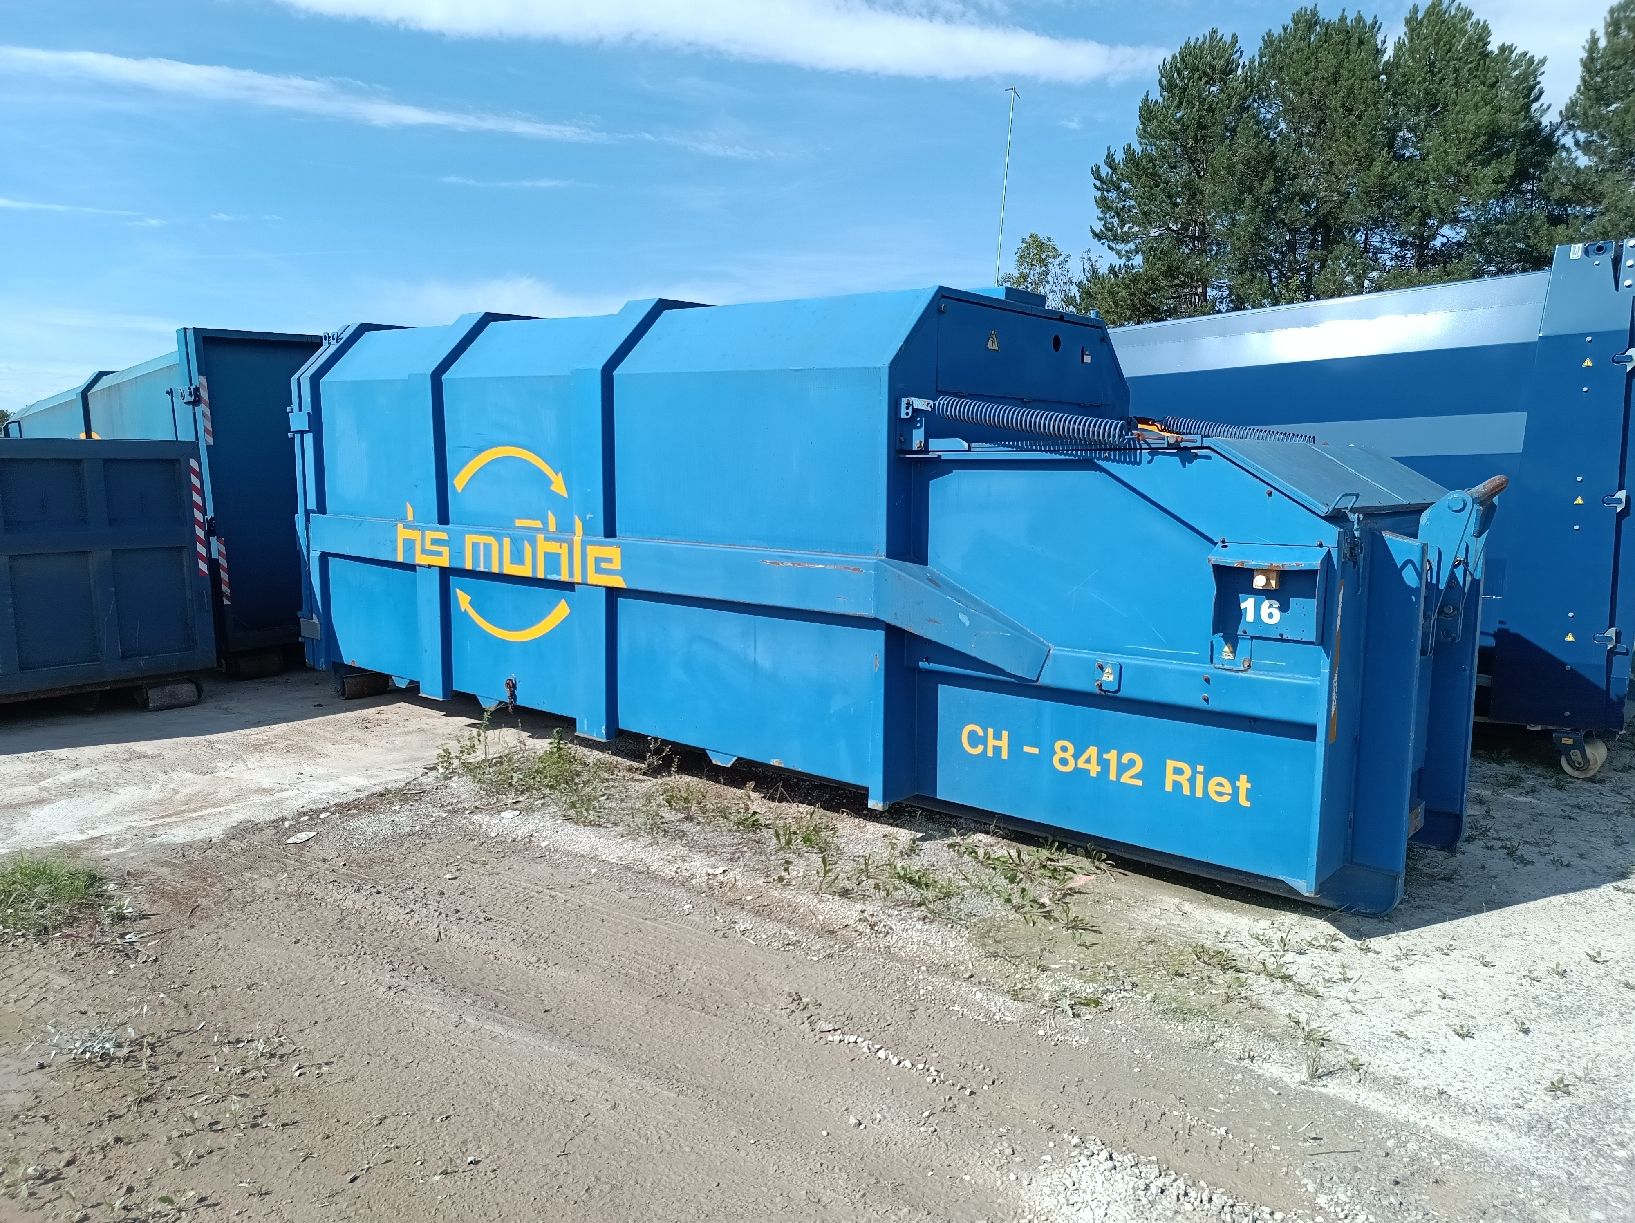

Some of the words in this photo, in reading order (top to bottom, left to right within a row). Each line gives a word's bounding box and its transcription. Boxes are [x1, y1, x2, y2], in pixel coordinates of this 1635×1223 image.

[397, 501, 449, 567] hs
[1240, 597, 1281, 624] 16
[961, 723, 1009, 760] CH
[1052, 740, 1144, 786] 8412
[1165, 758, 1252, 807] Riet
